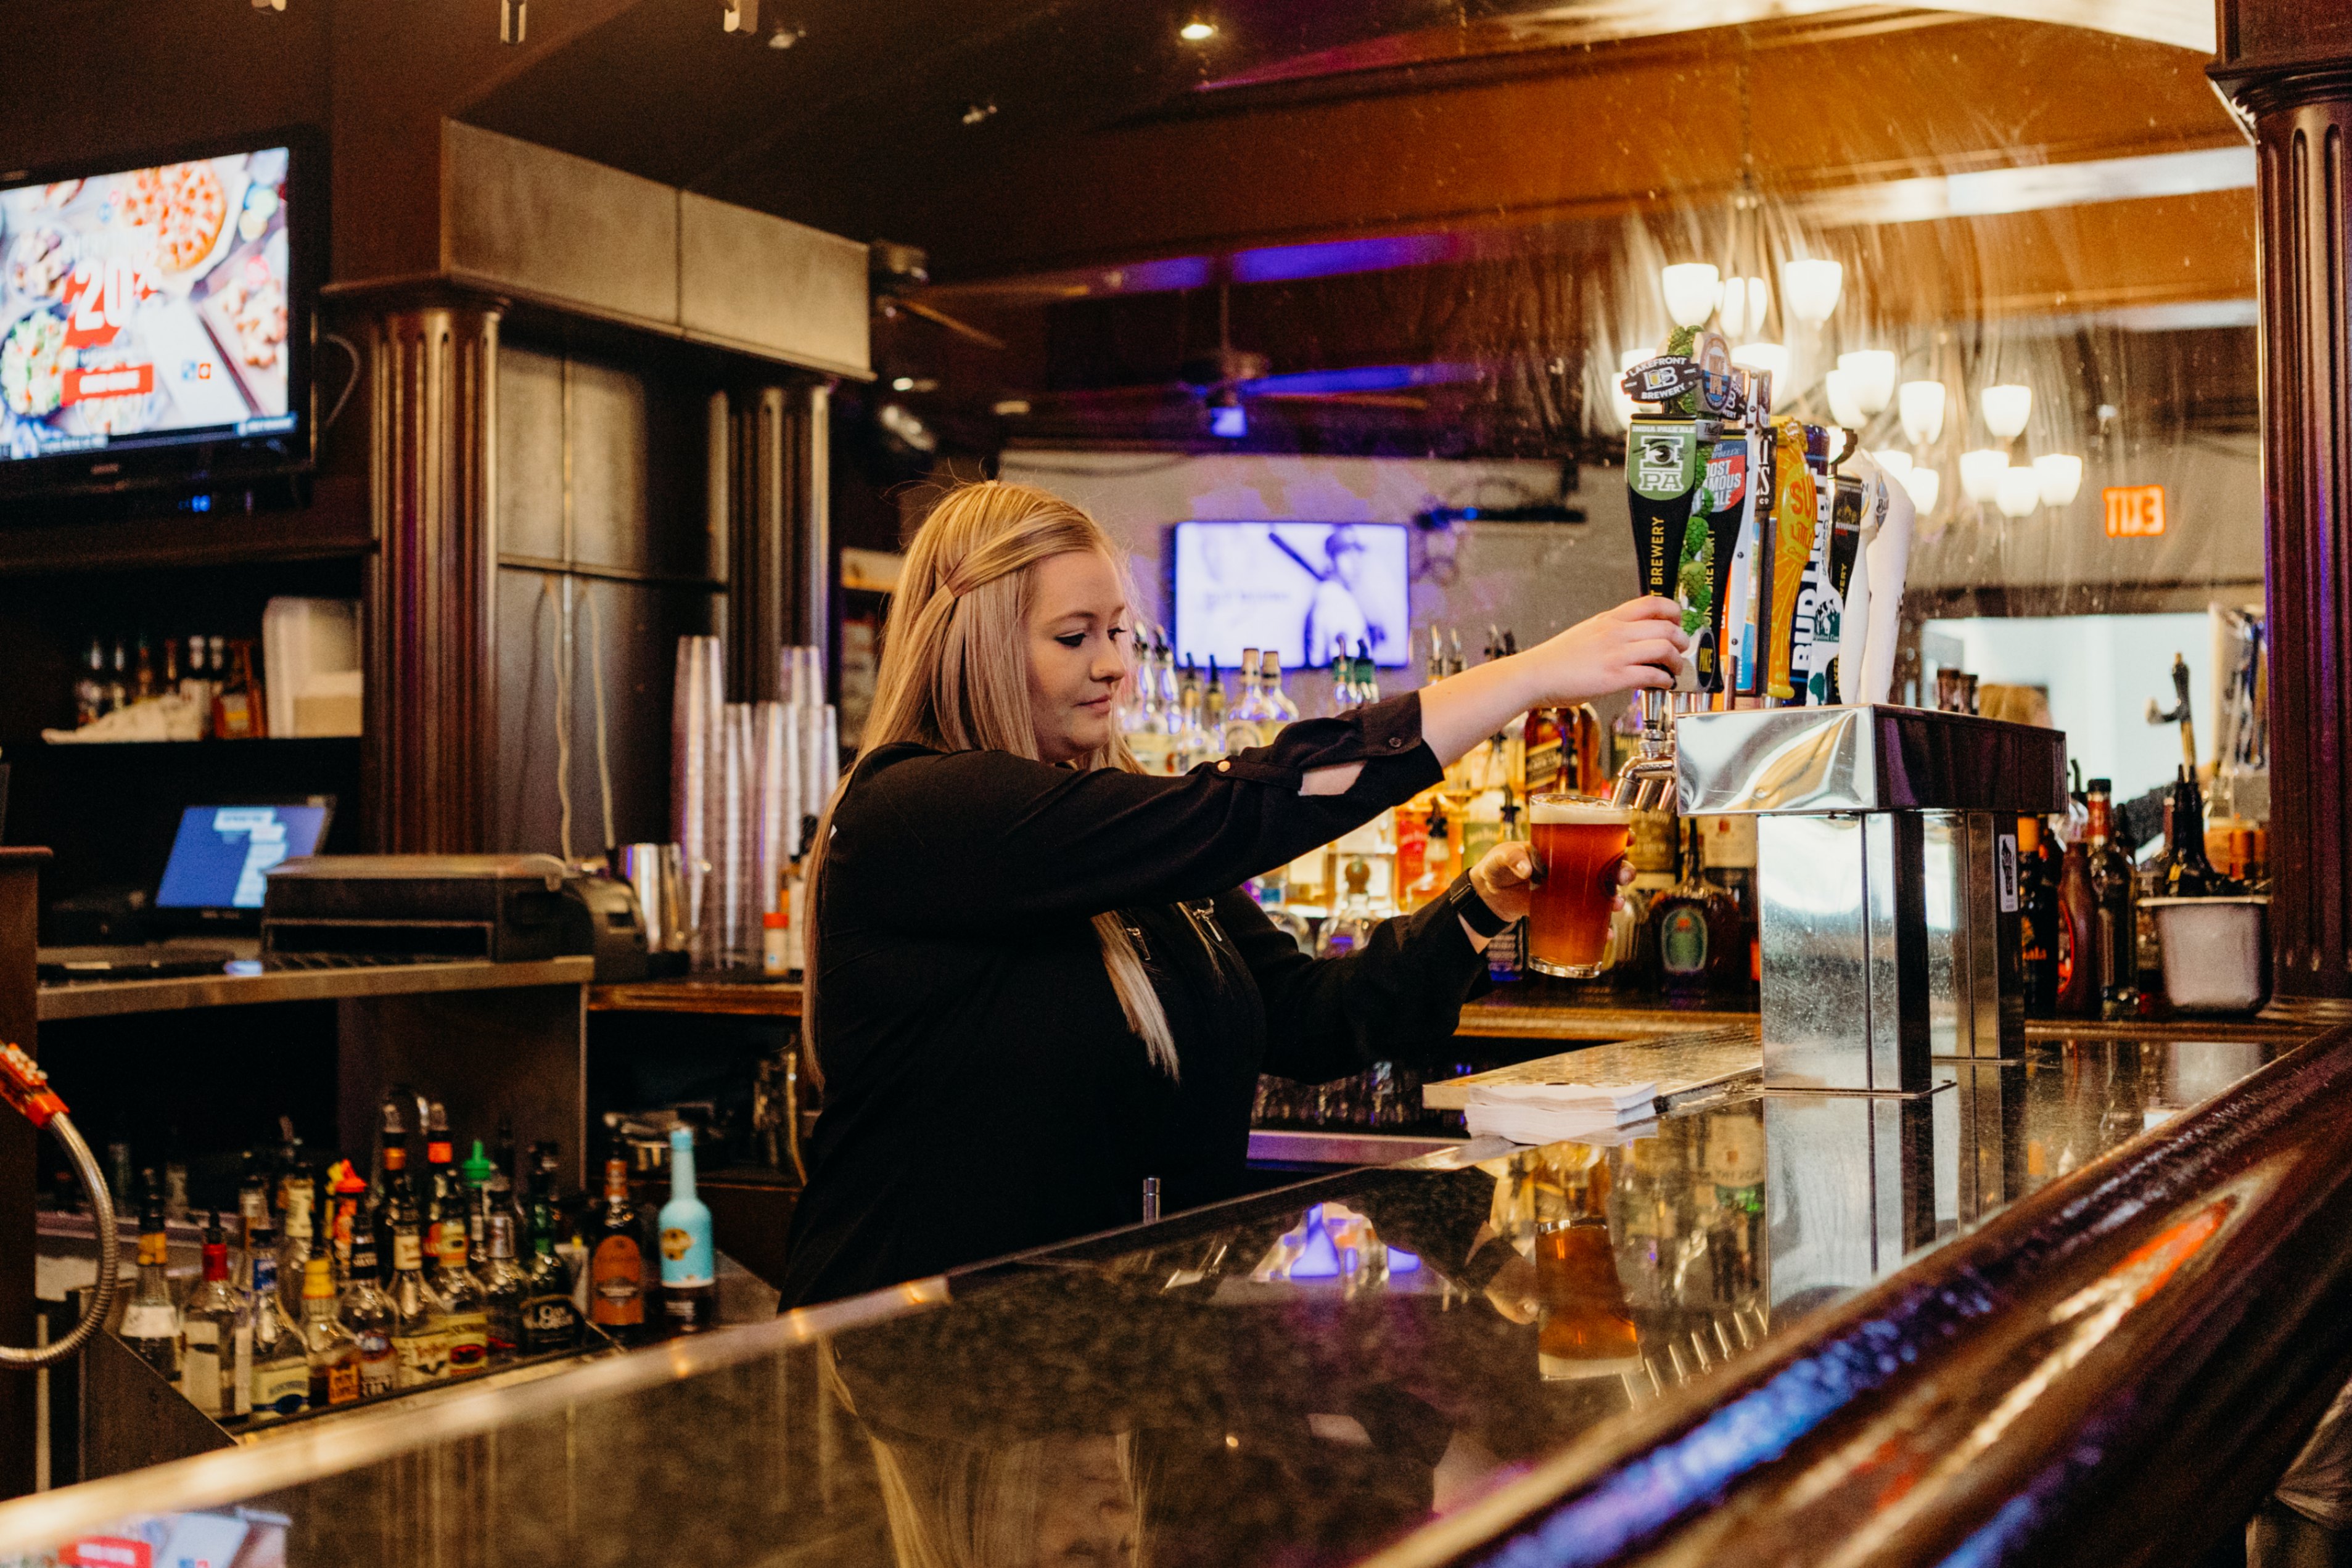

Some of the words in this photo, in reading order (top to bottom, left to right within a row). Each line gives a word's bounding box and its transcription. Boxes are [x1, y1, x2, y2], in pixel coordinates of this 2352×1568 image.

[1629, 356, 1687, 377] LAKEFRONT
[1641, 382, 1685, 400] BREWERY
[1703, 473, 1741, 490] AMOUS
[1651, 516, 1664, 585] BREWERY
[1792, 588, 1817, 671] BUD
